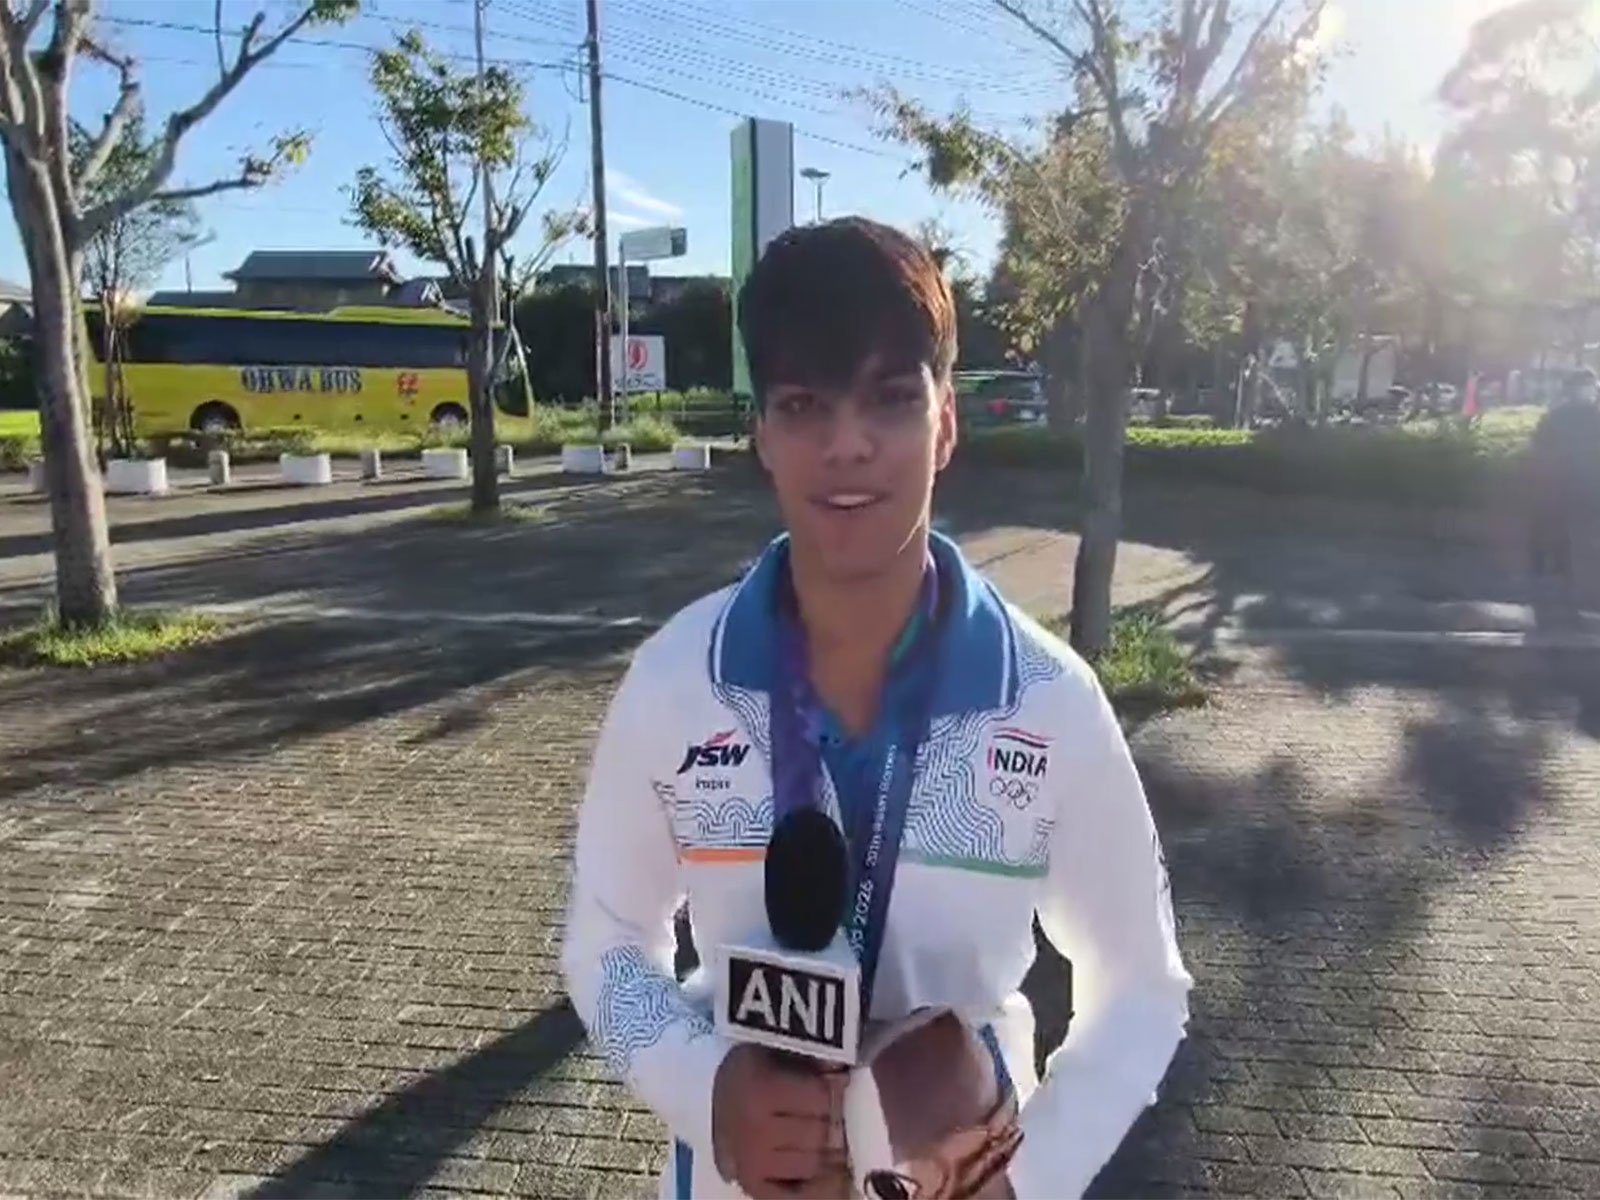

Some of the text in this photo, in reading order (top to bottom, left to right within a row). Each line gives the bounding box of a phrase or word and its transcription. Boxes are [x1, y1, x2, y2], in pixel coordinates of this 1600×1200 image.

[319, 367, 363, 393] BUS
[676, 744, 751, 774] JSW
[987, 746, 1047, 777] INDIA
[853, 879, 874, 925] 2026
[736, 968, 836, 1040] ANI
